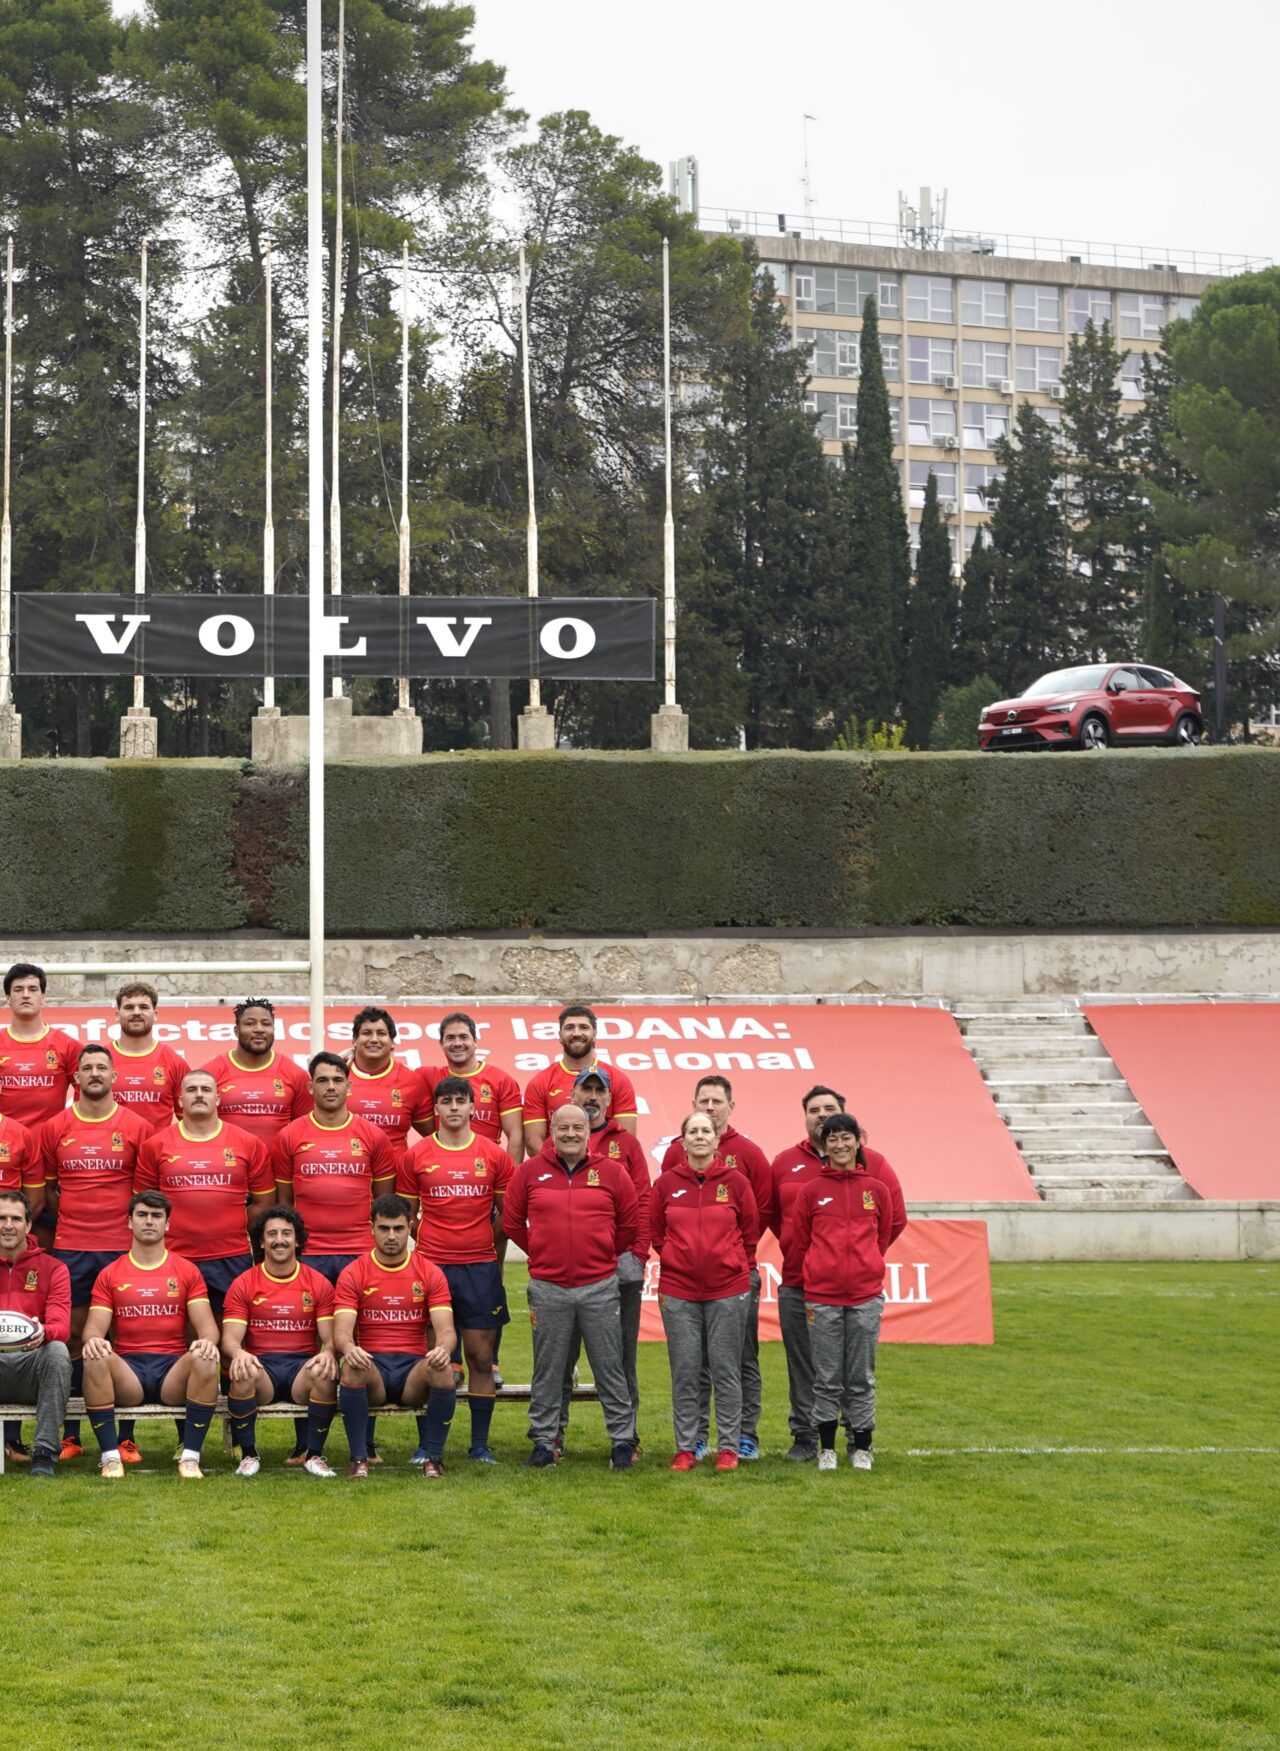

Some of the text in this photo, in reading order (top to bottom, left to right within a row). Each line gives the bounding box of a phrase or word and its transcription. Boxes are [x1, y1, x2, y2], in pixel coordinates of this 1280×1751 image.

[63, 1158, 122, 1171] GENERALI
[301, 1162, 366, 1175] GENERALI
[167, 1173, 232, 1187] GENERALI
[430, 1184, 489, 1198] GENERALI
[117, 1304, 180, 1317] GENERALI
[363, 1308, 423, 1321] GENERALI
[251, 1318, 312, 1331] GENERALI
